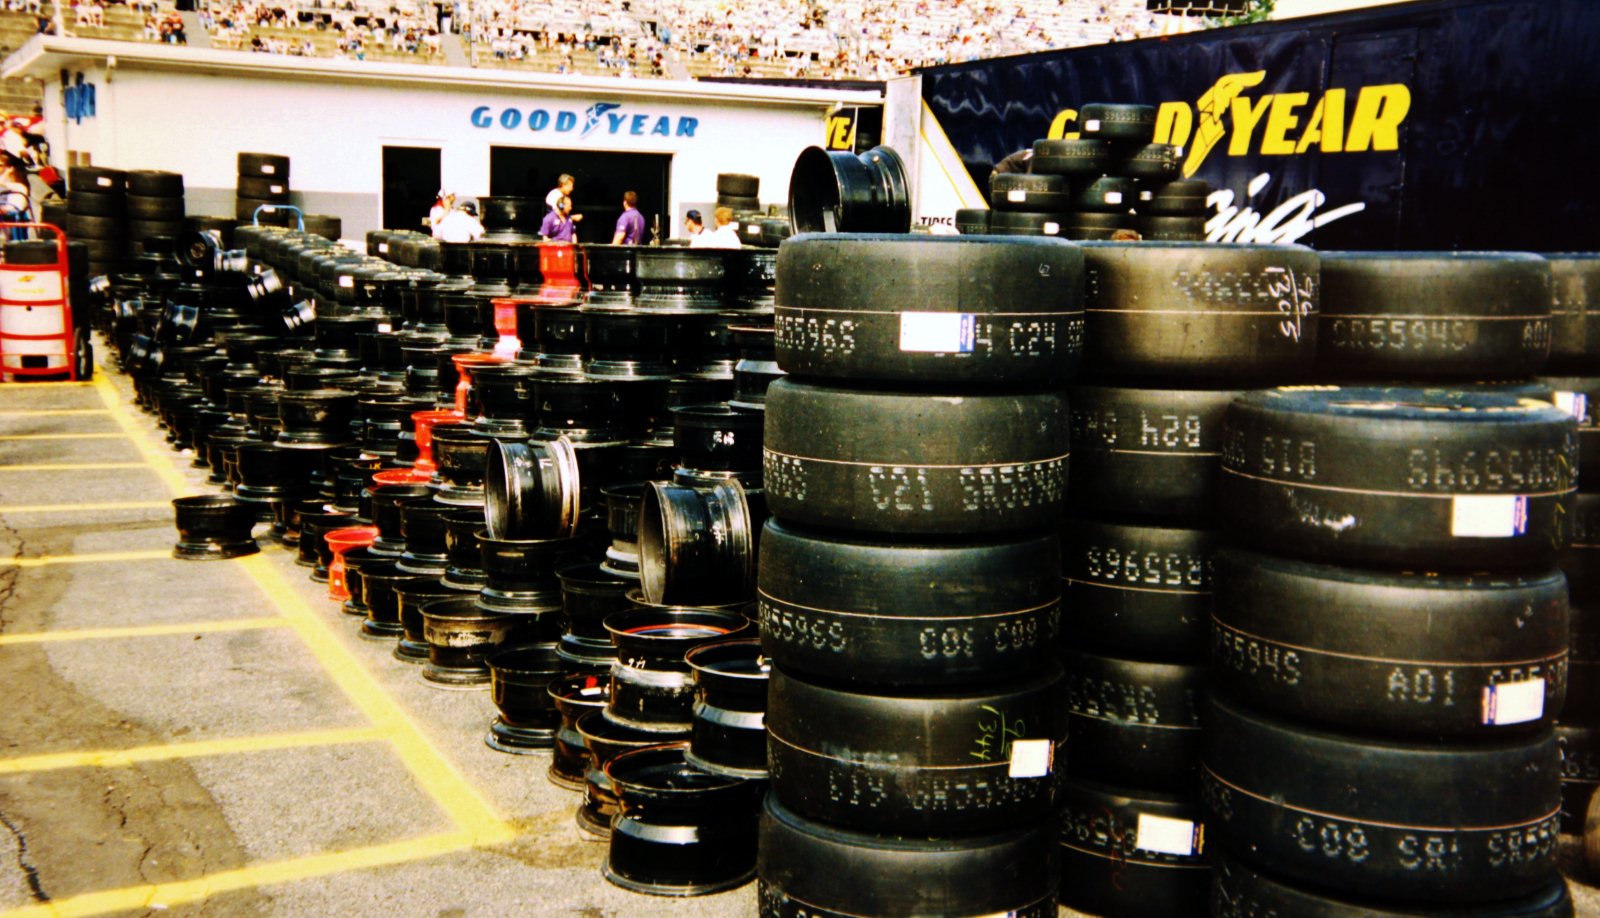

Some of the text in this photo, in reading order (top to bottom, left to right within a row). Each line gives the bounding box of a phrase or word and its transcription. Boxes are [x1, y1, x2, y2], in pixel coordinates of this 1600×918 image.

[1010, 321, 1056, 356] C24
[1141, 411, 1201, 447] B24
[1388, 666, 1456, 706] A01
